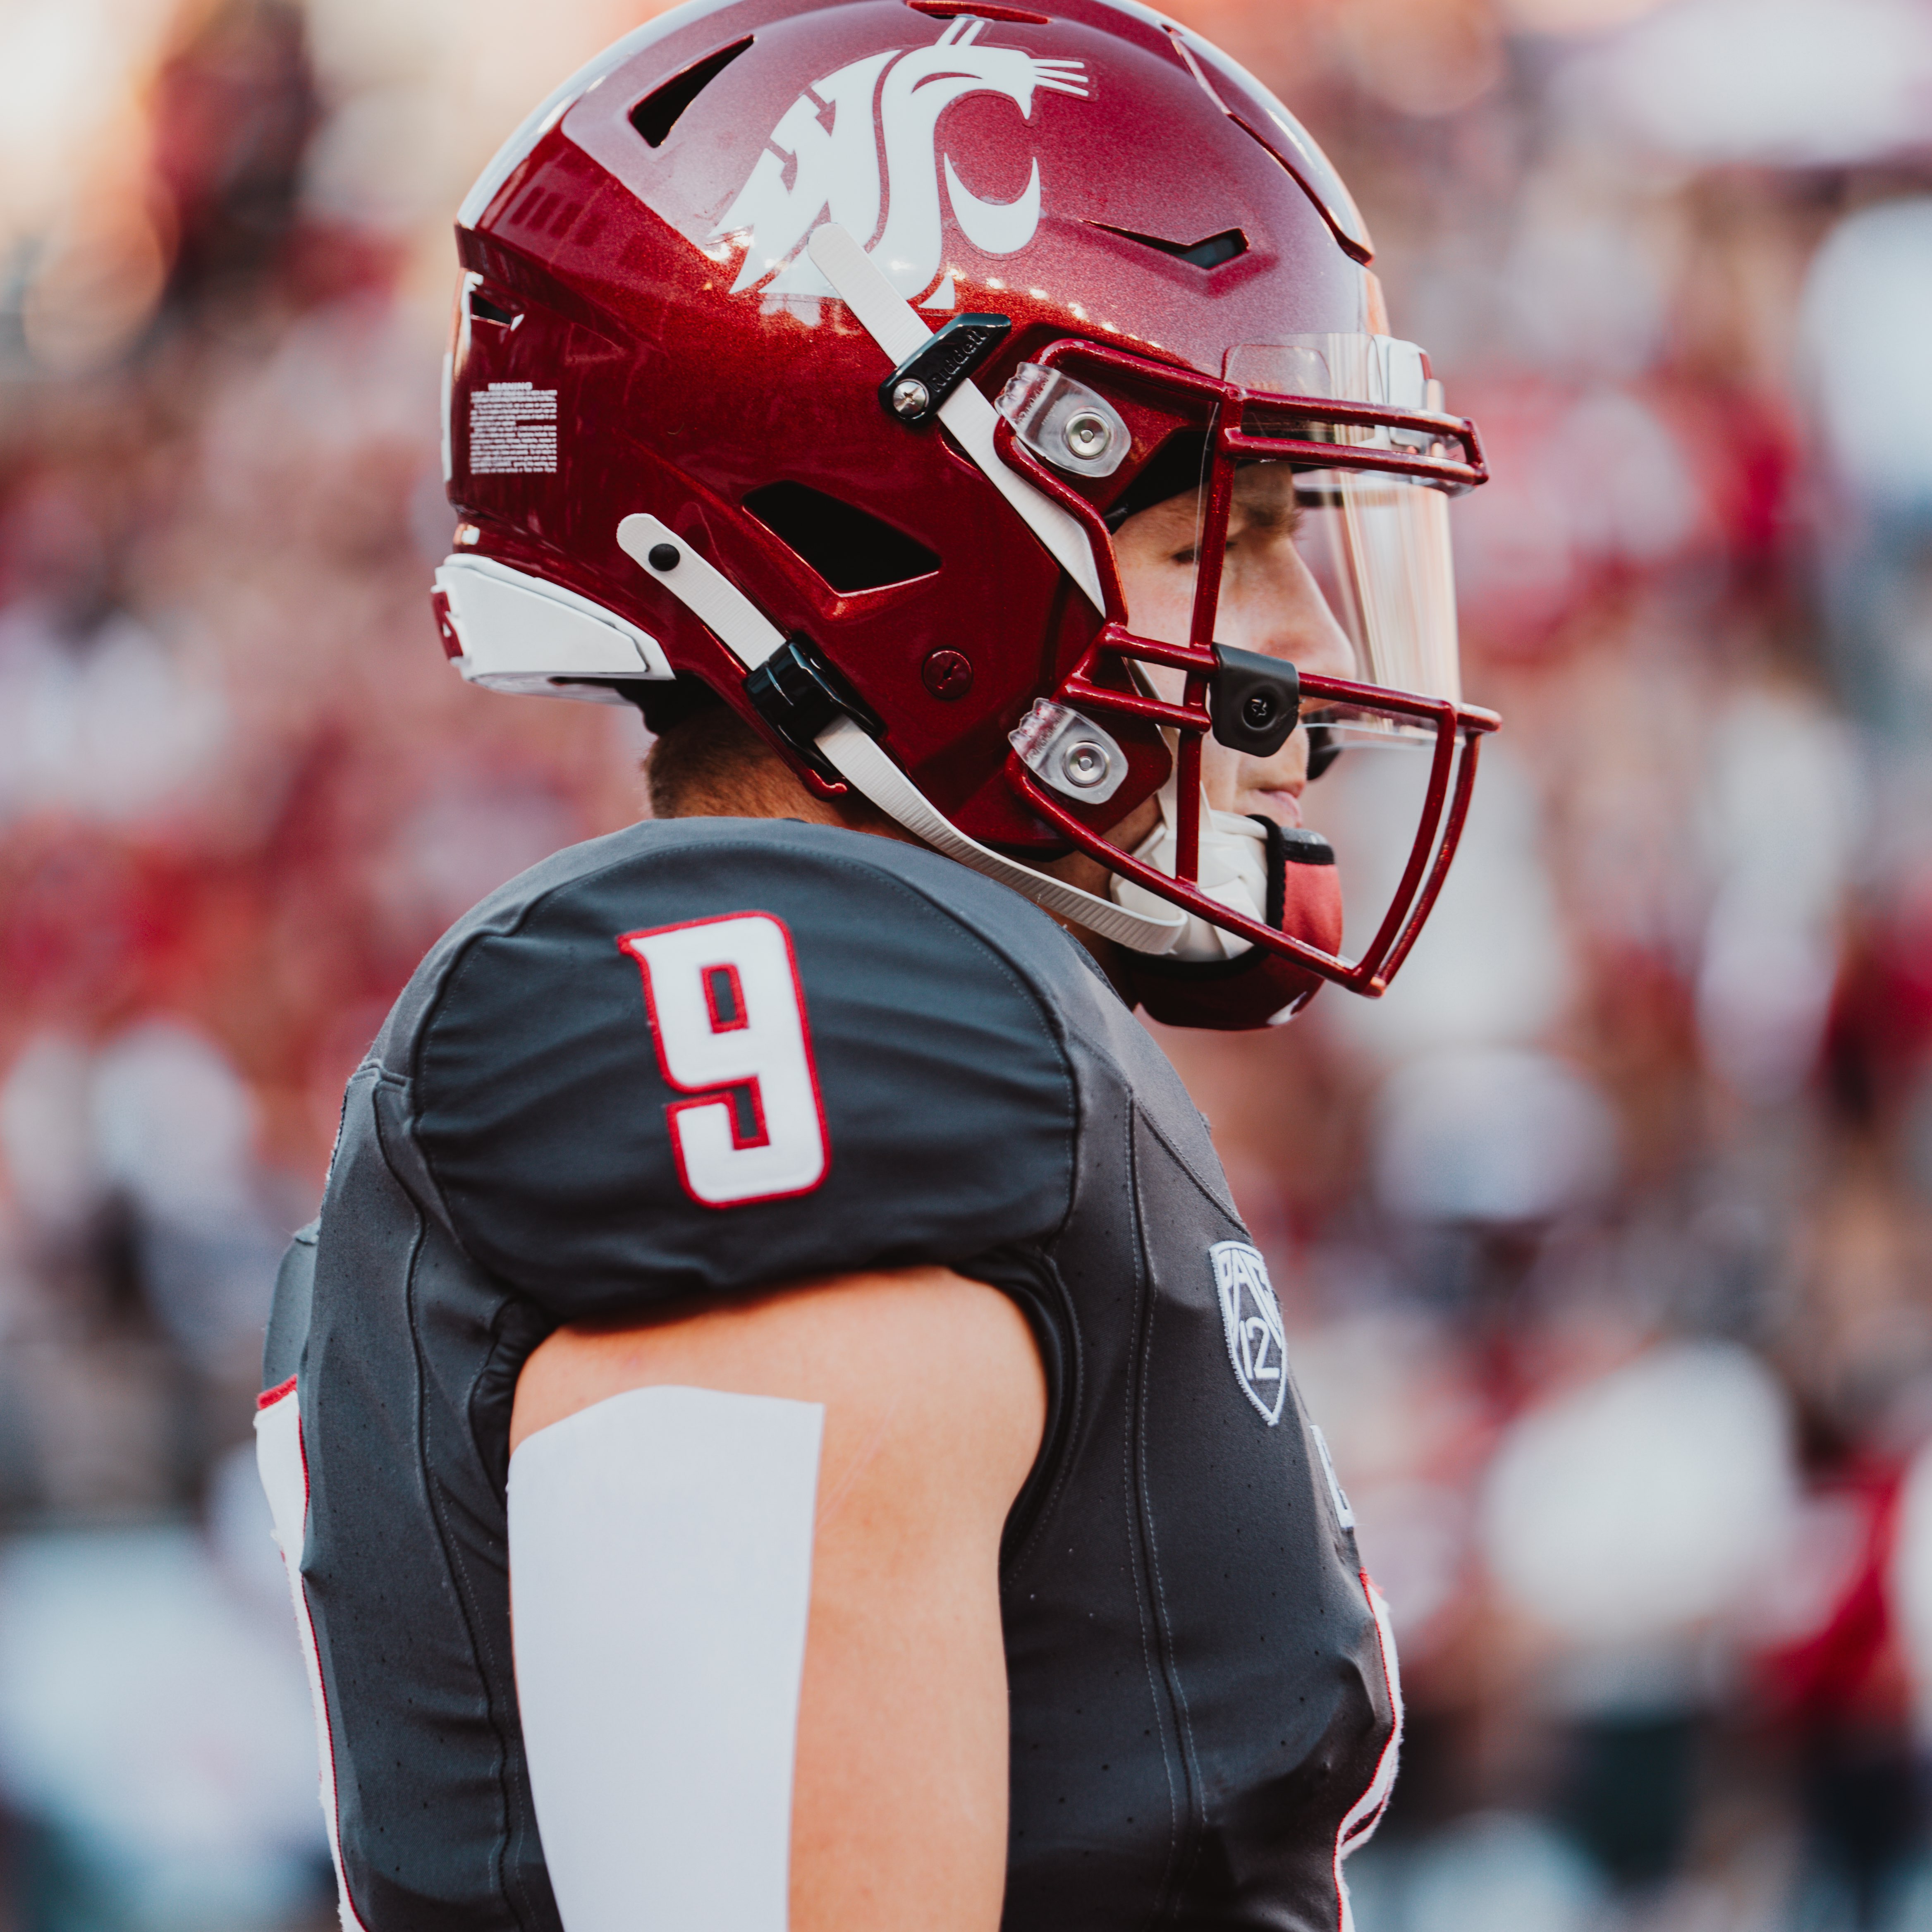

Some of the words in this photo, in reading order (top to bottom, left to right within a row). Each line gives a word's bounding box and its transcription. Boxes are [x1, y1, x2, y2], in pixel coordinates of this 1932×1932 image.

[927, 330, 988, 393] Riddell
[616, 910, 831, 1209] 9
[1239, 1317, 1280, 1380] 12
